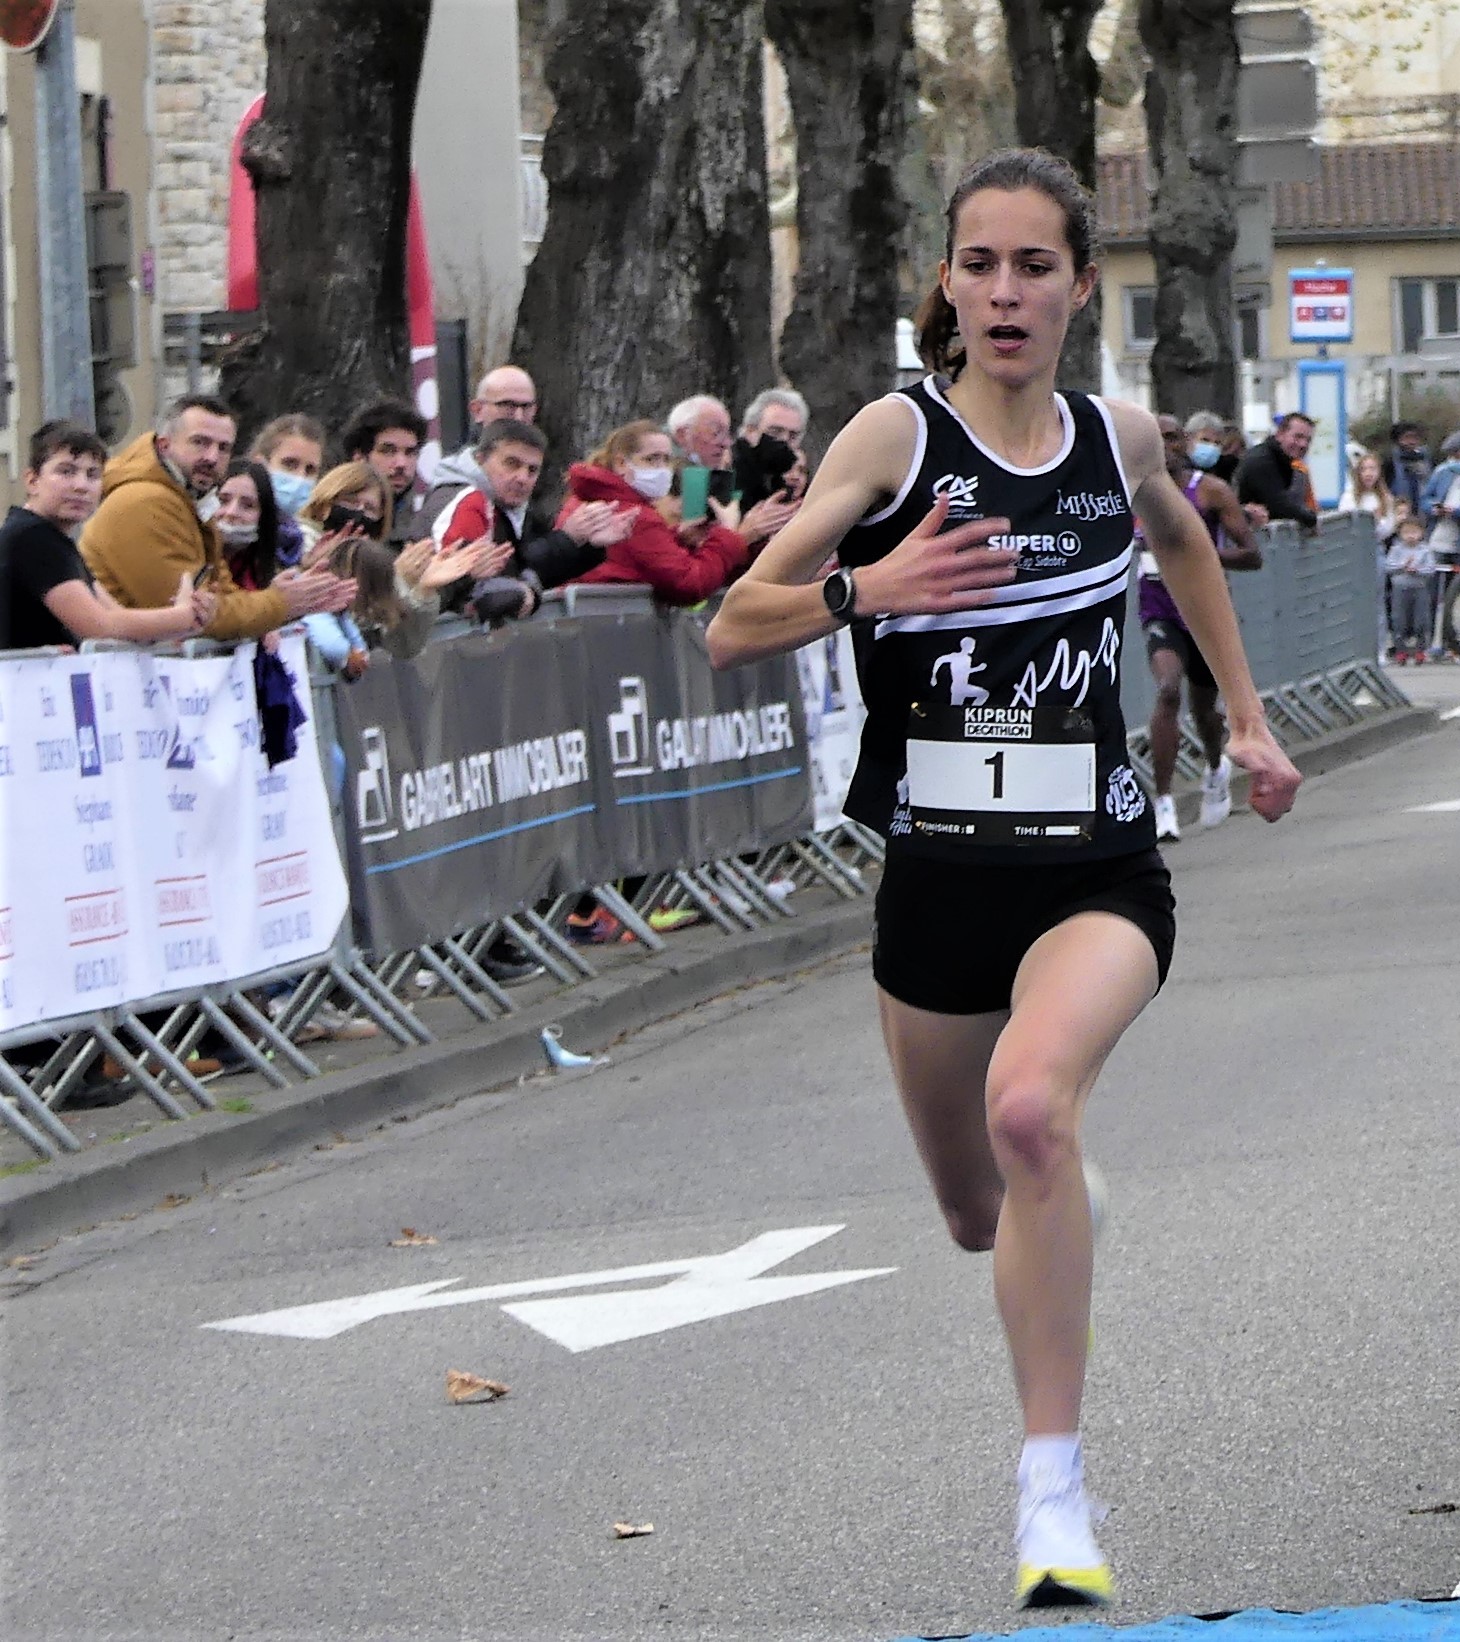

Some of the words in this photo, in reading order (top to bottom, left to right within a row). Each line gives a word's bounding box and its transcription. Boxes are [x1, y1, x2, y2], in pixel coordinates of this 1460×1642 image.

[987, 534, 1056, 552] SUPER
[964, 707, 1033, 723] KIPRUN
[967, 724, 1030, 737] DECATHLON
[984, 751, 1004, 798] 1
